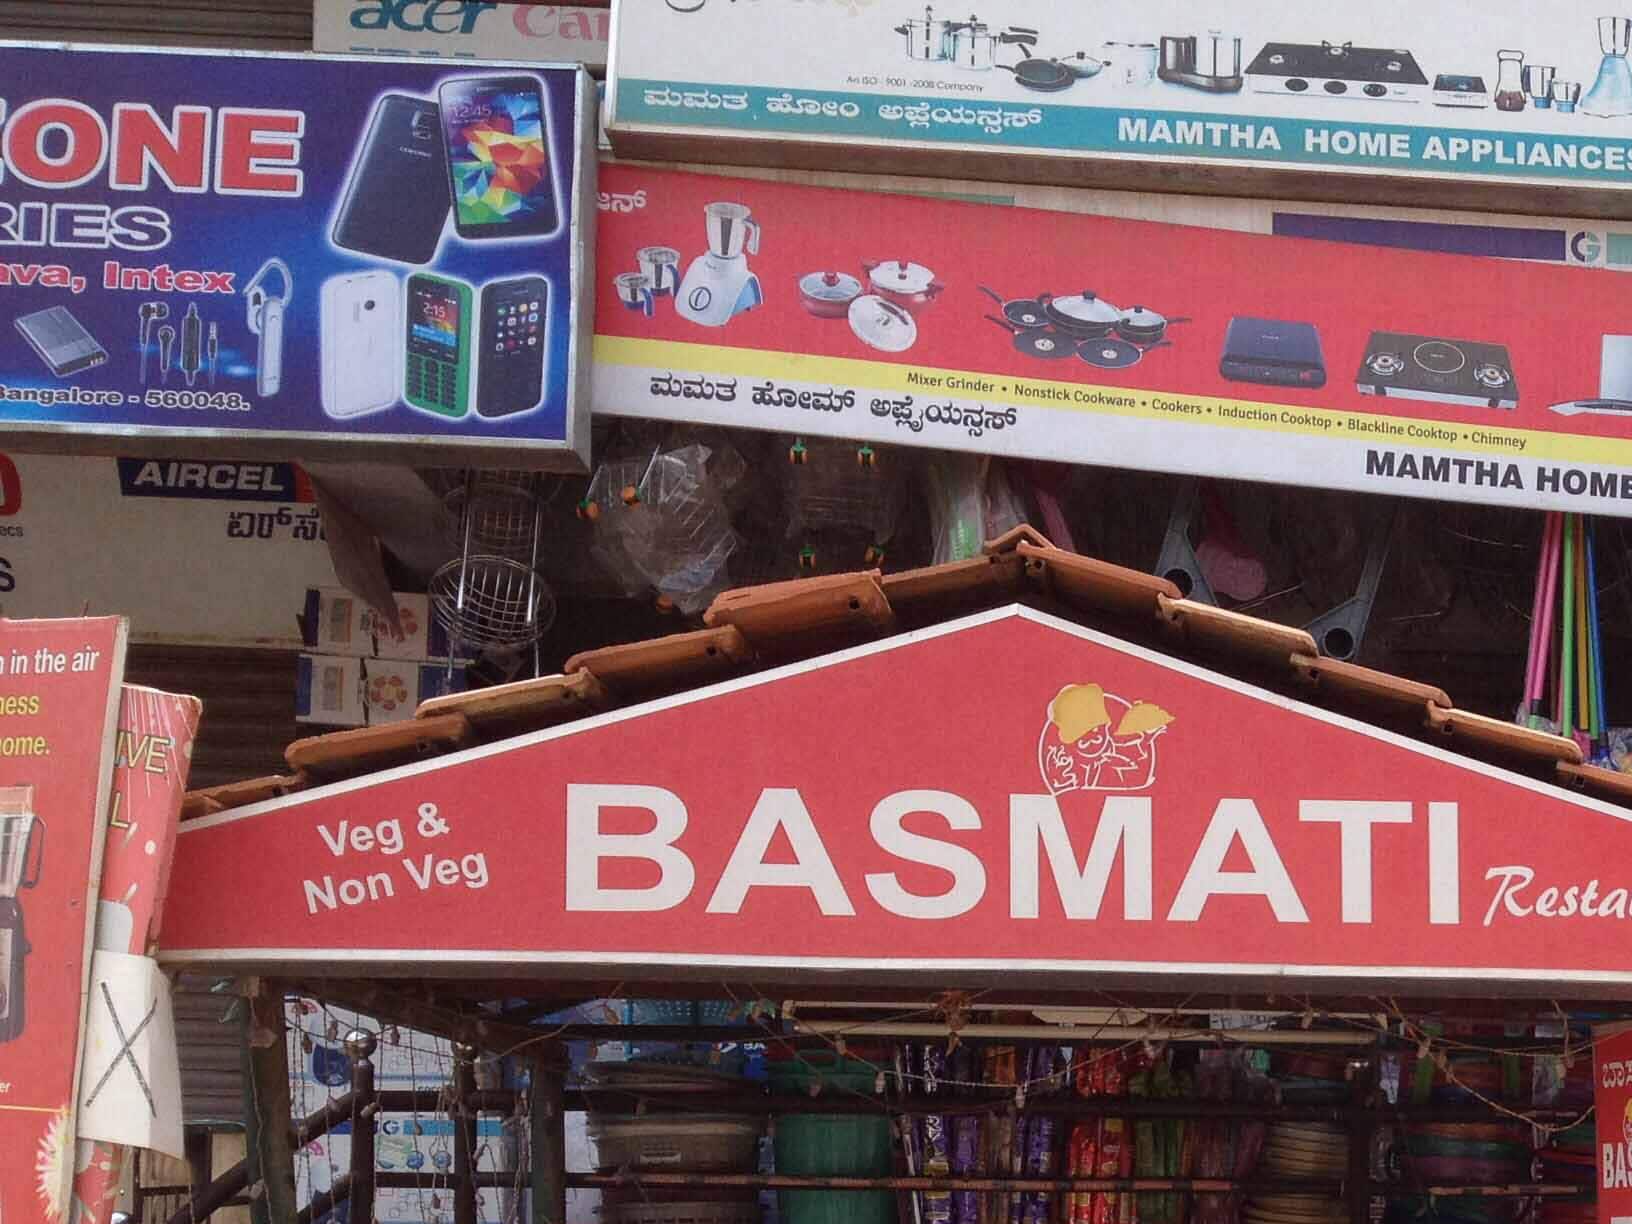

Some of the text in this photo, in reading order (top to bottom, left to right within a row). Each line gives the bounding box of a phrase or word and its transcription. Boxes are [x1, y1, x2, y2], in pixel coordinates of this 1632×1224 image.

[0, 98, 305, 197] ONE
[1118, 118, 1282, 152] MAMTHA
[1304, 128, 1411, 159] HOME
[104, 261, 235, 294] Intex
[907, 373, 1527, 450] Mixer Grinder Nonstick Cookware Cookers Induction Cooktop Blackline Cooktop Chimney
[134, 462, 284, 492] AIRCEL
[1365, 449, 1524, 491] MAMTHA
[10, 649, 28, 674] in
[34, 648, 67, 673] the
[72, 646, 99, 672] air
[317, 801, 450, 858] Veg &
[565, 783, 1461, 927] BASMATI
[303, 848, 491, 914] Non Veg
